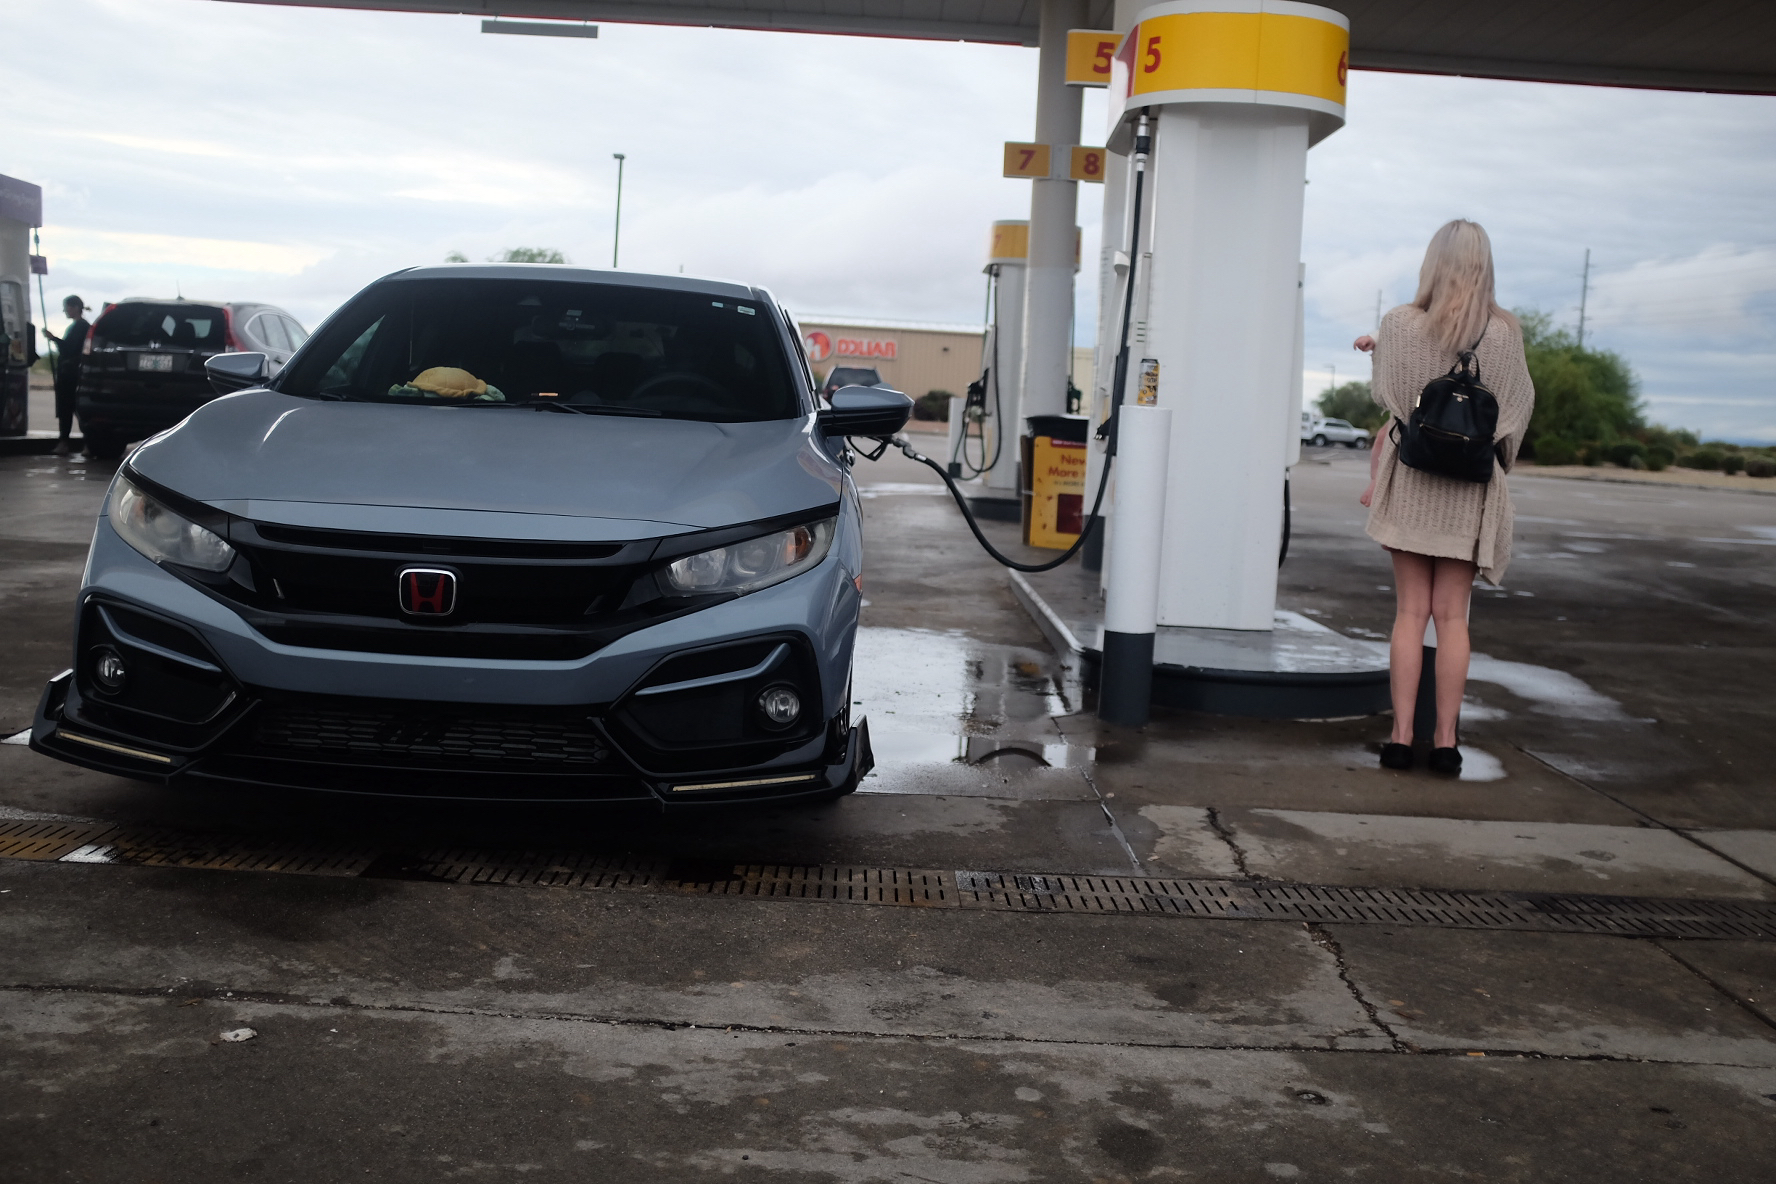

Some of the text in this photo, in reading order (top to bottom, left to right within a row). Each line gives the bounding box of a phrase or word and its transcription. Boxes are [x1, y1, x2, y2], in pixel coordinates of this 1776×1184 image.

[1093, 41, 1115, 74] 5
[1144, 35, 1162, 74] 5
[1019, 149, 1036, 171] 7
[1083, 152, 1100, 176] 8
[1048, 466, 1079, 479] More
